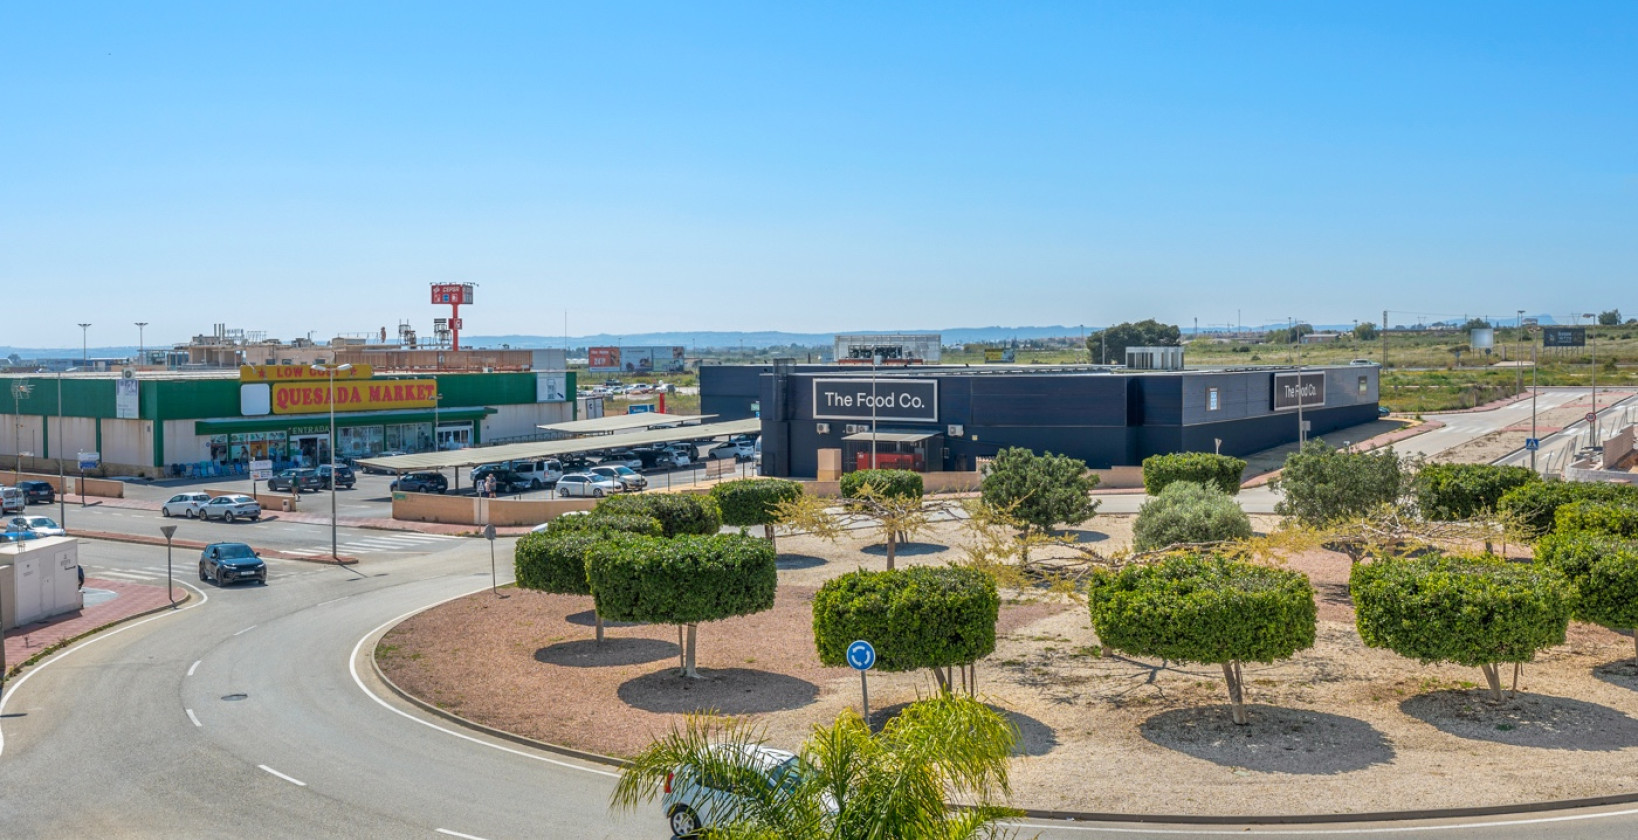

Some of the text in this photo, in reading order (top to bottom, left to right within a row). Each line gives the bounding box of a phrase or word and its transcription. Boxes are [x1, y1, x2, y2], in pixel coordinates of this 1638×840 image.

[276, 366, 303, 378] LOW
[276, 384, 435, 410] QUESADA MARKET
[1284, 385, 1295, 398] The
[824, 392, 925, 408] The Food Co.
[292, 425, 330, 435] ENTRADA
